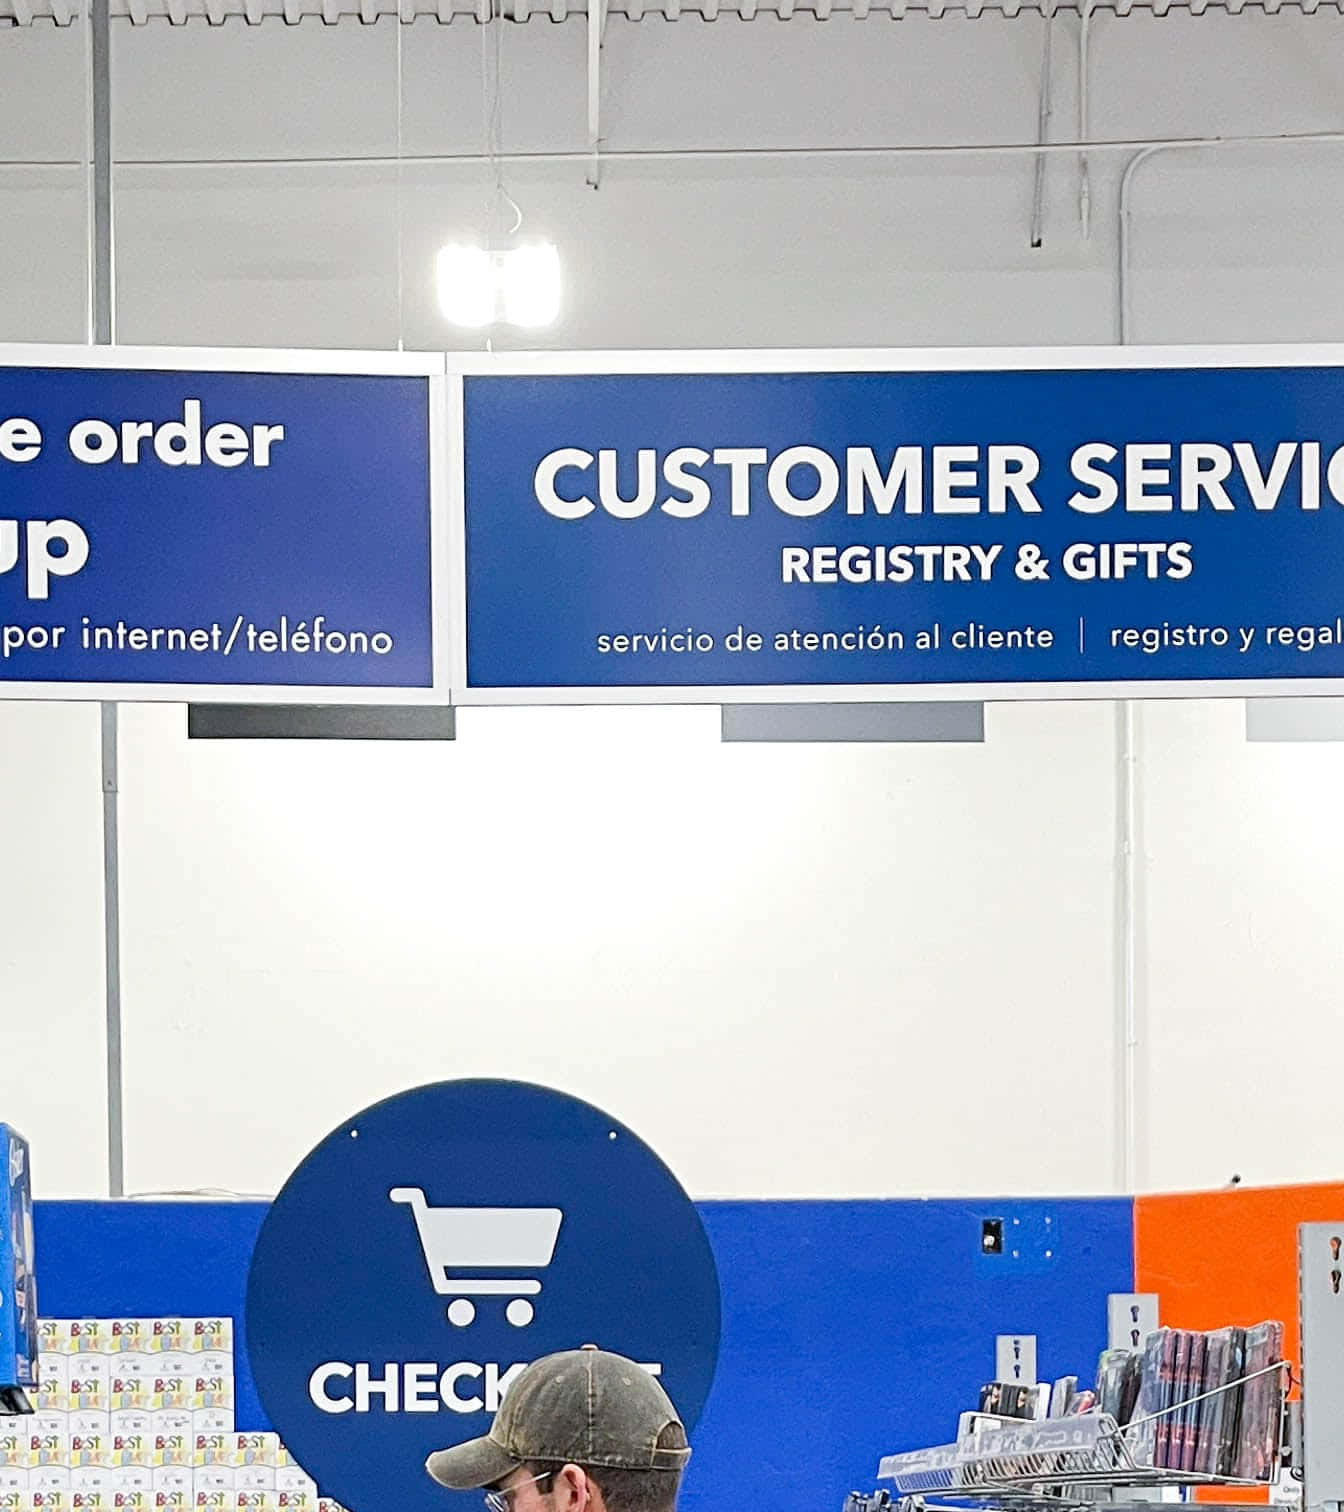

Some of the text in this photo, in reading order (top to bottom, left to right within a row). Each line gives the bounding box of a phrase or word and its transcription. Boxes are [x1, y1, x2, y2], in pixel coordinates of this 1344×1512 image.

[69, 399, 285, 467] order
[534, 445, 1043, 520] CUSTOMER
[781, 542, 1194, 583] REGISTRY & GIFTS
[2, 621, 66, 657] por
[82, 615, 394, 657] internet/teléfono
[597, 621, 1055, 653] servicio de atención al cliente
[1111, 622, 1229, 653] registro
[1239, 624, 1255, 652] y
[309, 1361, 662, 1414] CHECK
